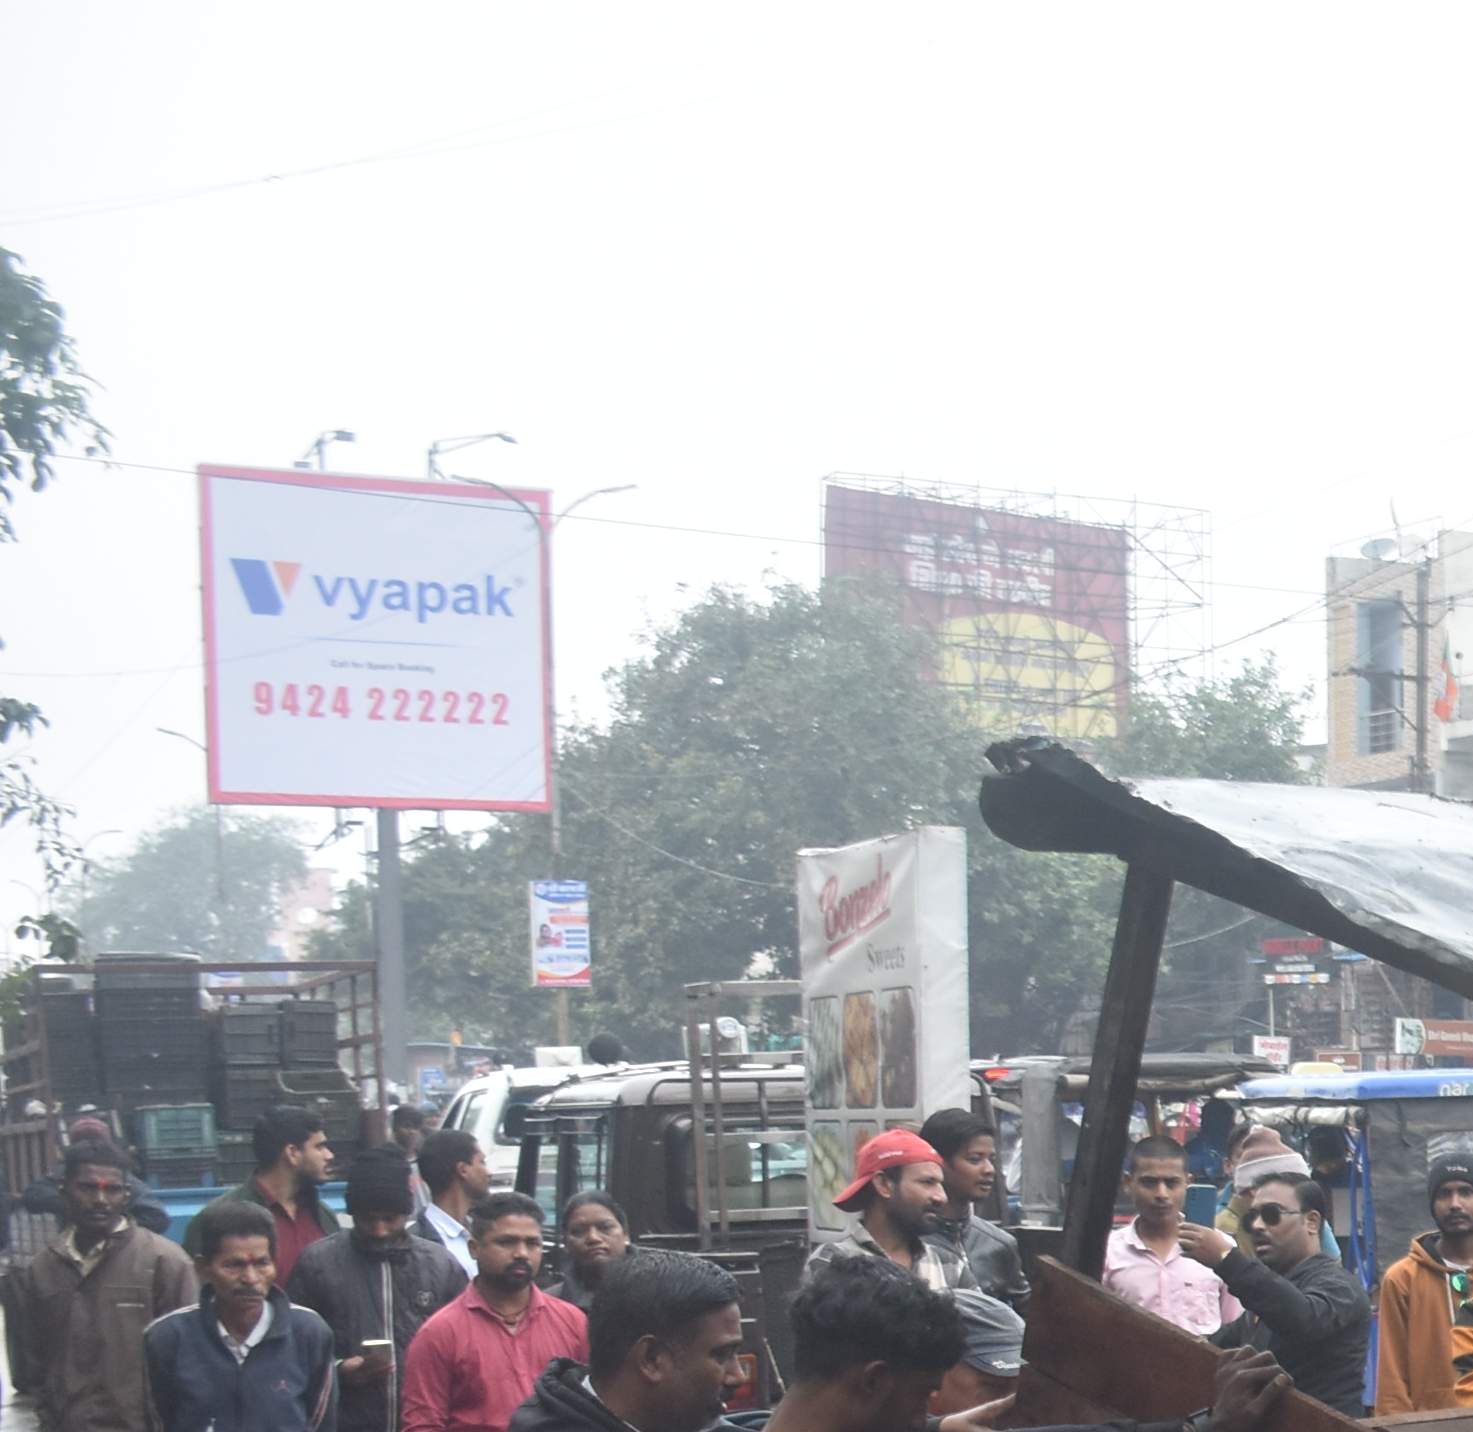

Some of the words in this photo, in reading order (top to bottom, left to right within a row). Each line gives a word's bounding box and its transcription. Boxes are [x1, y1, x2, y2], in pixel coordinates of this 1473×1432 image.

[312, 574, 514, 624] vyapak
[253, 682, 352, 719] 9424
[367, 687, 511, 726] 222222
[866, 943, 905, 973] Sweets
